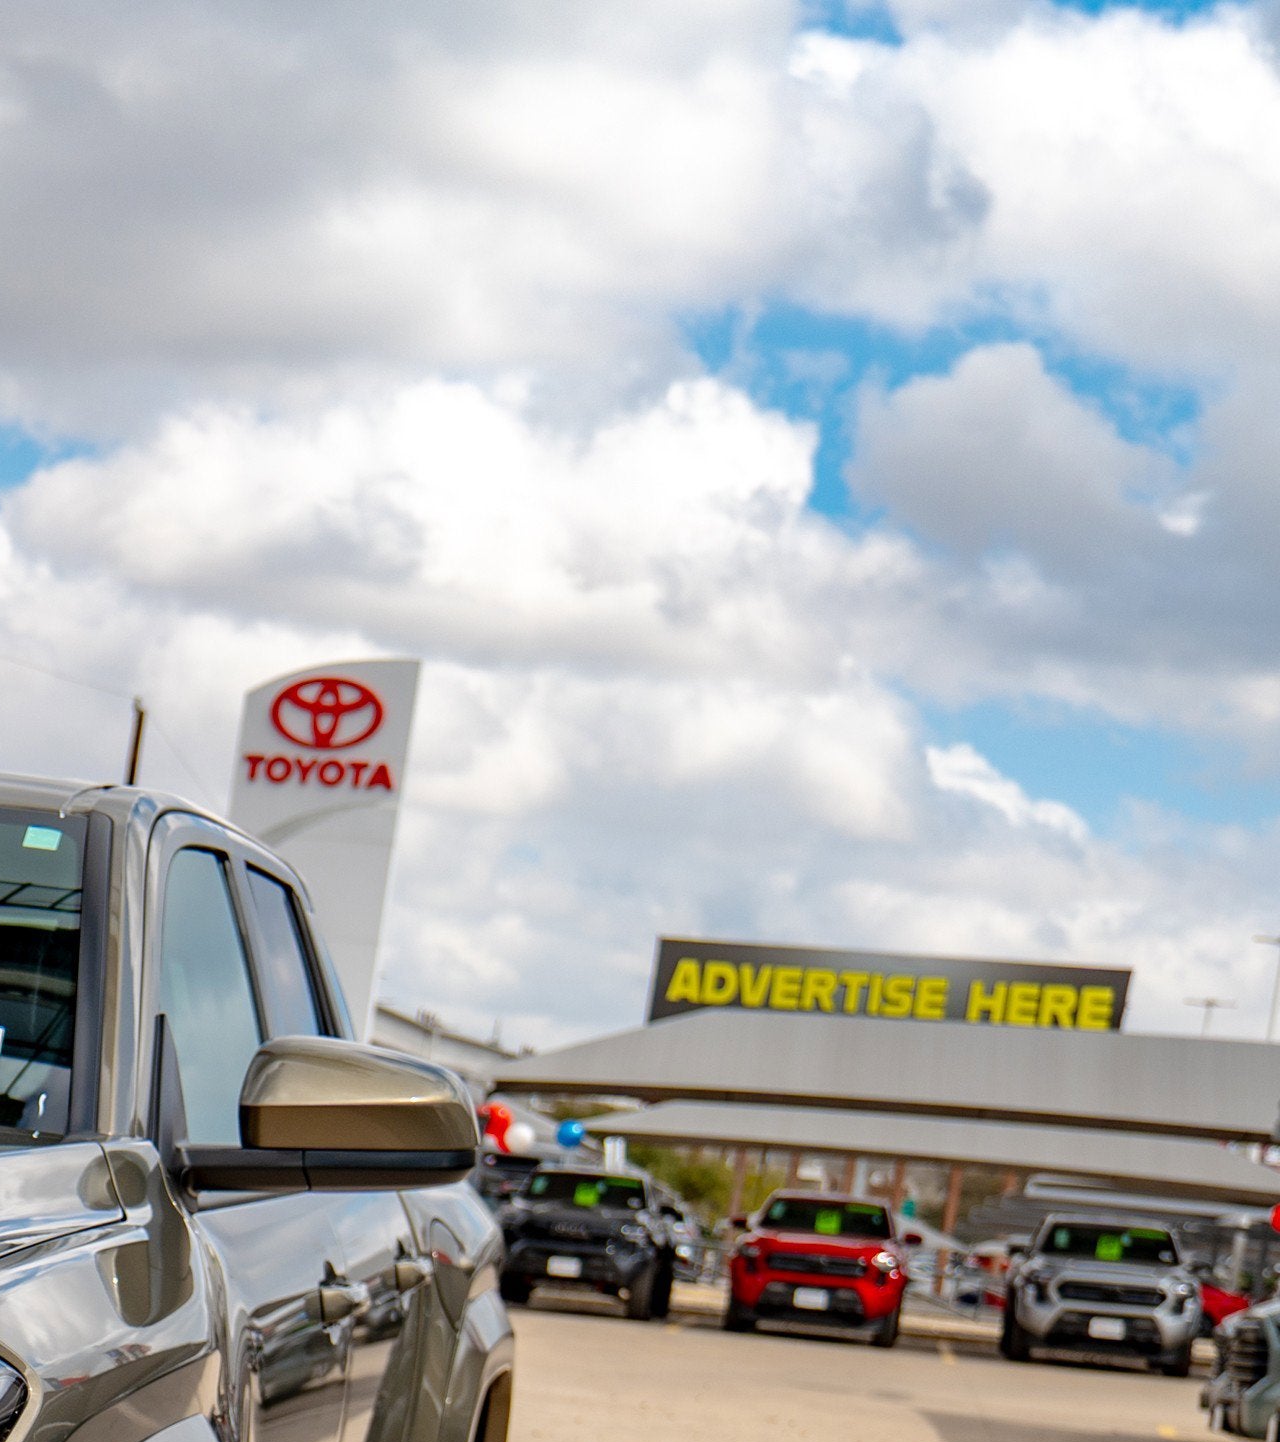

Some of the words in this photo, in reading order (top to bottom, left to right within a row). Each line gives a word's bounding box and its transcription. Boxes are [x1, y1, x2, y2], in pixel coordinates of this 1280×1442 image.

[244, 755, 393, 791] TOYOTA
[666, 957, 948, 1020] ADVERTISE
[967, 981, 1115, 1030] HERE
